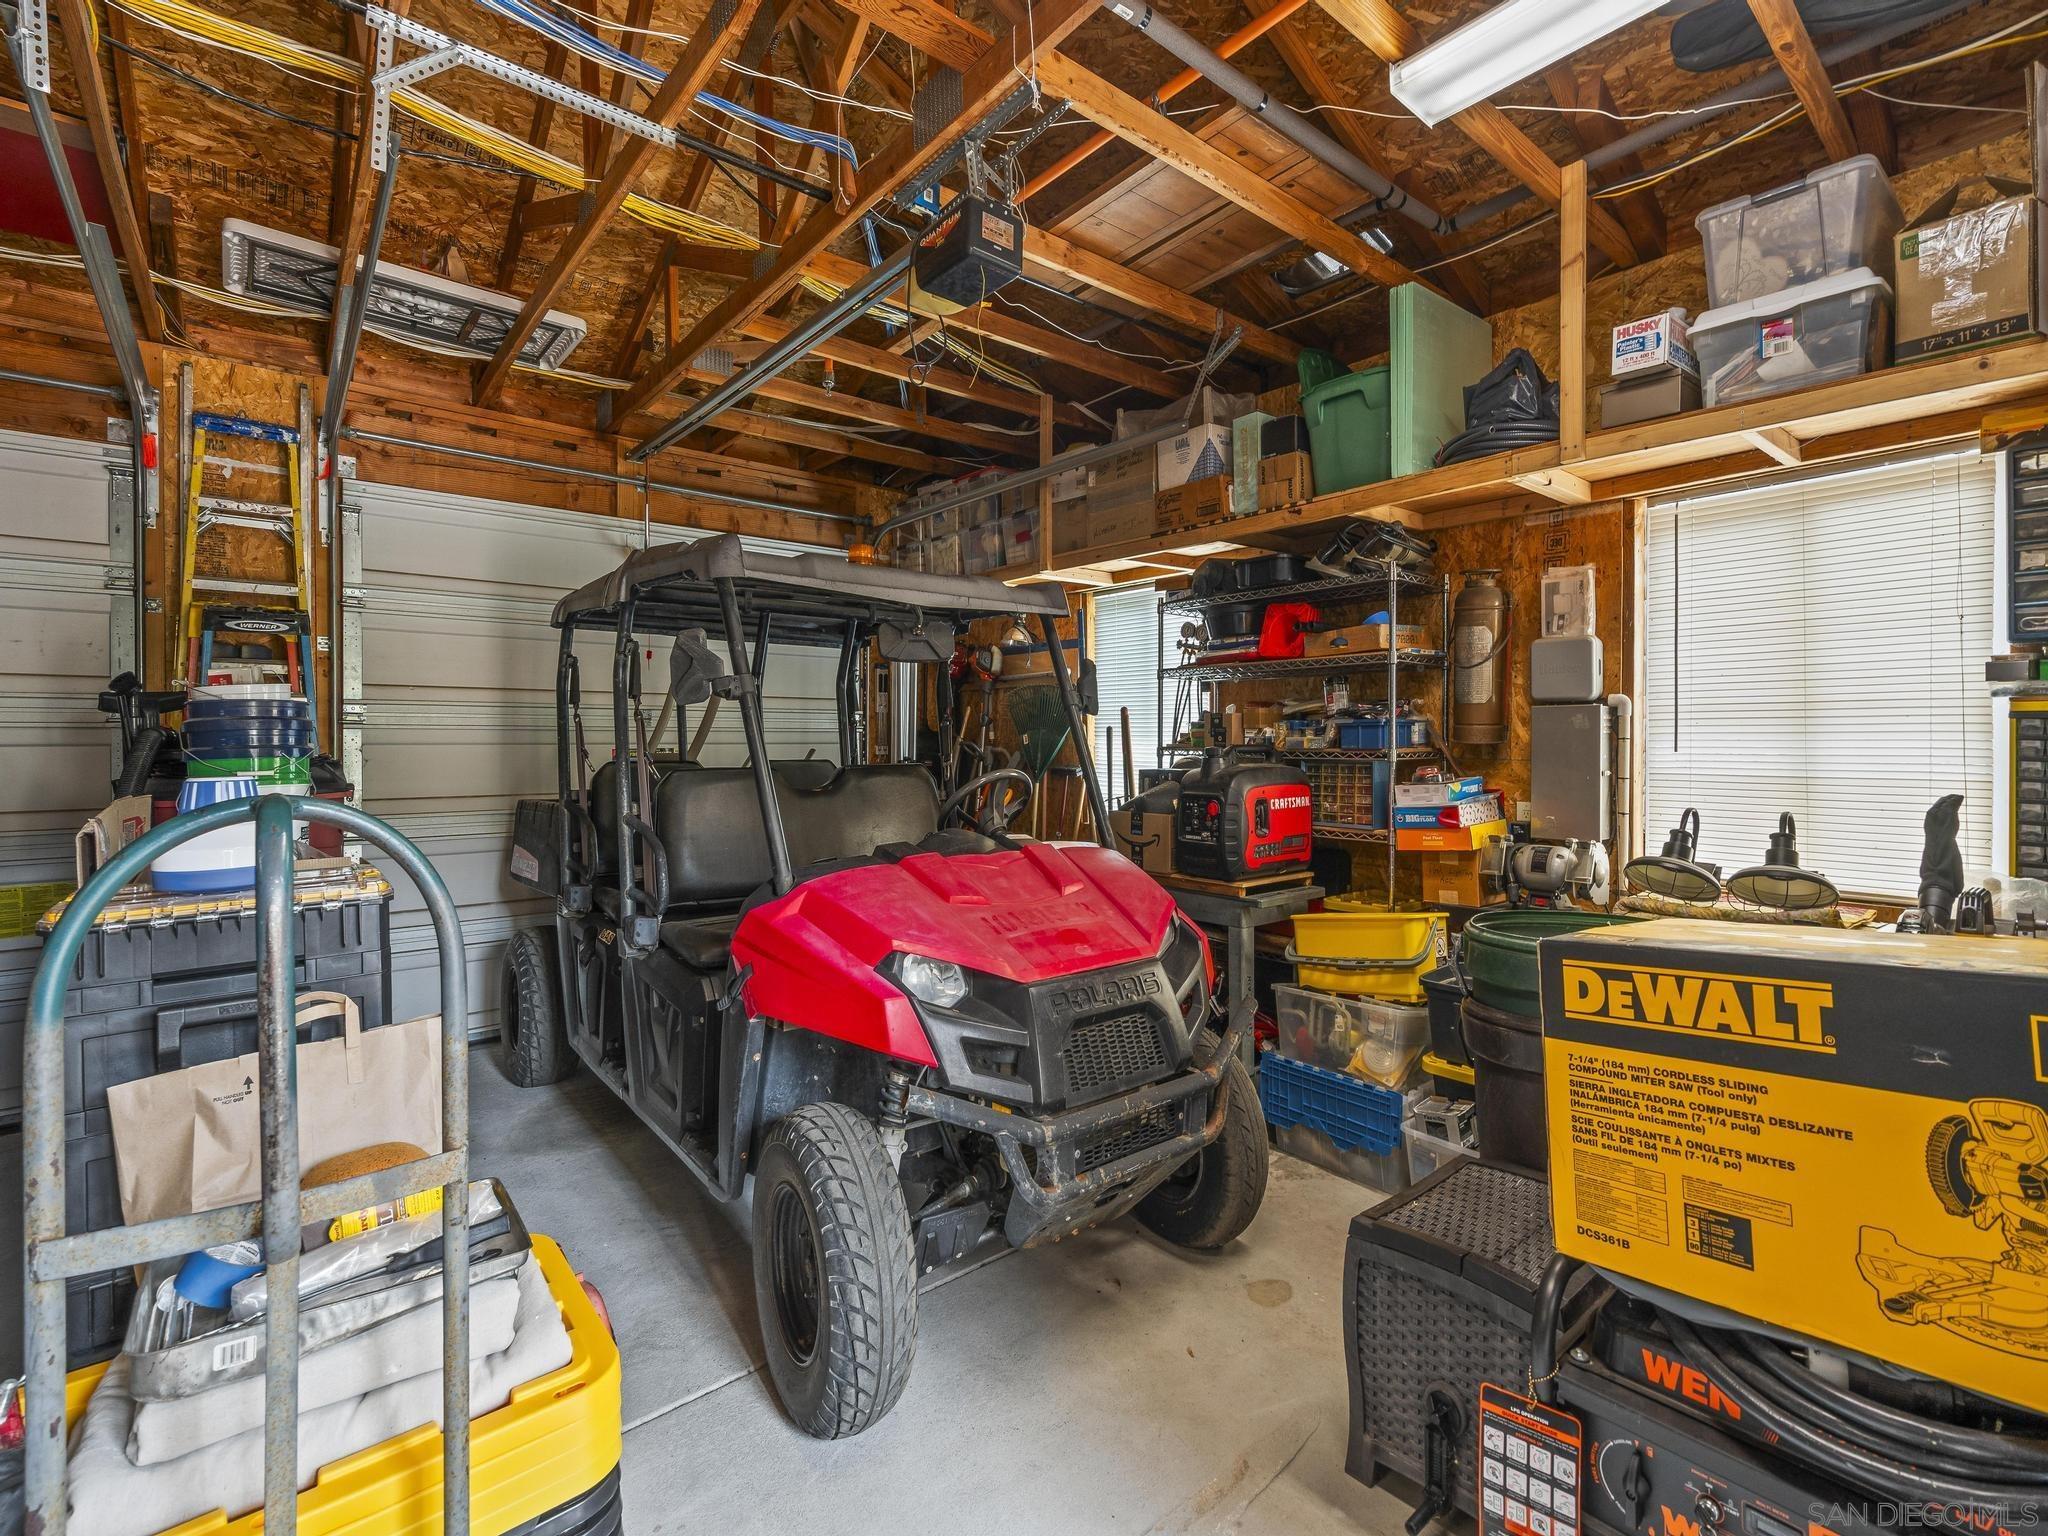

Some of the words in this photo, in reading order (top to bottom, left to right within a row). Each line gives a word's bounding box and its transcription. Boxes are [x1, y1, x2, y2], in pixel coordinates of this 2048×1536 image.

[920, 209, 961, 247] QUANTUM
[1905, 244, 1919, 255] GEA
[1617, 317, 1662, 340] HUSKY
[1922, 337, 1942, 351] 17"
[1945, 336, 1954, 345] x
[1958, 327, 1977, 342] 11"
[1982, 328, 1990, 337] x
[1994, 320, 2017, 334] 13"
[240, 622, 277, 630] WERNER
[1271, 796, 1311, 811] CRAFTSMAN
[1050, 970, 1162, 1018] POLARIS
[1568, 1063, 1628, 1081] COMPOUND
[1631, 1074, 1666, 1088] MITER
[1669, 1081, 1694, 1093] SAW
[1697, 1086, 1724, 1098] (Tool
[1728, 1092, 1757, 1105] only)
[1602, 1059, 1625, 1070] (184
[1627, 1063, 1650, 1076] mm)
[1653, 1067, 1715, 1086] CORDLESS
[1718, 1078, 1769, 1095] SLIDING
[1569, 1079, 1606, 1093] SIERRA
[1609, 1088, 1685, 1109] INGLETADORA
[1688, 1102, 1765, 1124] COMPUESTA
[1768, 1116, 1854, 1141] DESLIZANTE
[1569, 1088, 1641, 1110] INALÁMBRICA
[1645, 1104, 1664, 1115] 184
[1667, 1109, 1688, 1120] mm
[1691, 1112, 1727, 1128] (7-1/4
[1731, 1122, 1761, 1136] pulg)
[1570, 1098, 1635, 1119] (Herramienta
[1638, 1112, 1706, 1135] únicamente)
[1571, 1114, 1594, 1127] SCIE
[1597, 1120, 1671, 1144] COULISSANTE
[1686, 1140, 1742, 1159] ONGLETS
[1746, 1152, 1797, 1171] MIXTES
[1571, 1124, 1598, 1138] SANS
[1601, 1131, 1617, 1142] FIL
[1619, 1135, 1634, 1146] DE
[1638, 1140, 1658, 1152] 184
[1661, 1146, 1682, 1157] mm
[1685, 1149, 1720, 1166] (7-1/4
[1723, 1160, 1742, 1172] po)
[1572, 1133, 1599, 1148] (Outil
[1601, 1142, 1658, 1163] seulement)
[1577, 1225, 1631, 1249] DCS361B
[1690, 1242, 1700, 1251] 90
[1642, 1348, 1742, 1421] WEN
[1501, 1410, 1519, 1422] QUICK
[1521, 1416, 1539, 1429] START
[1540, 1423, 1559, 1437] GUIDE
[1510, 1406, 1520, 1414] LPG
[1520, 1410, 1549, 1426] OPERATION
